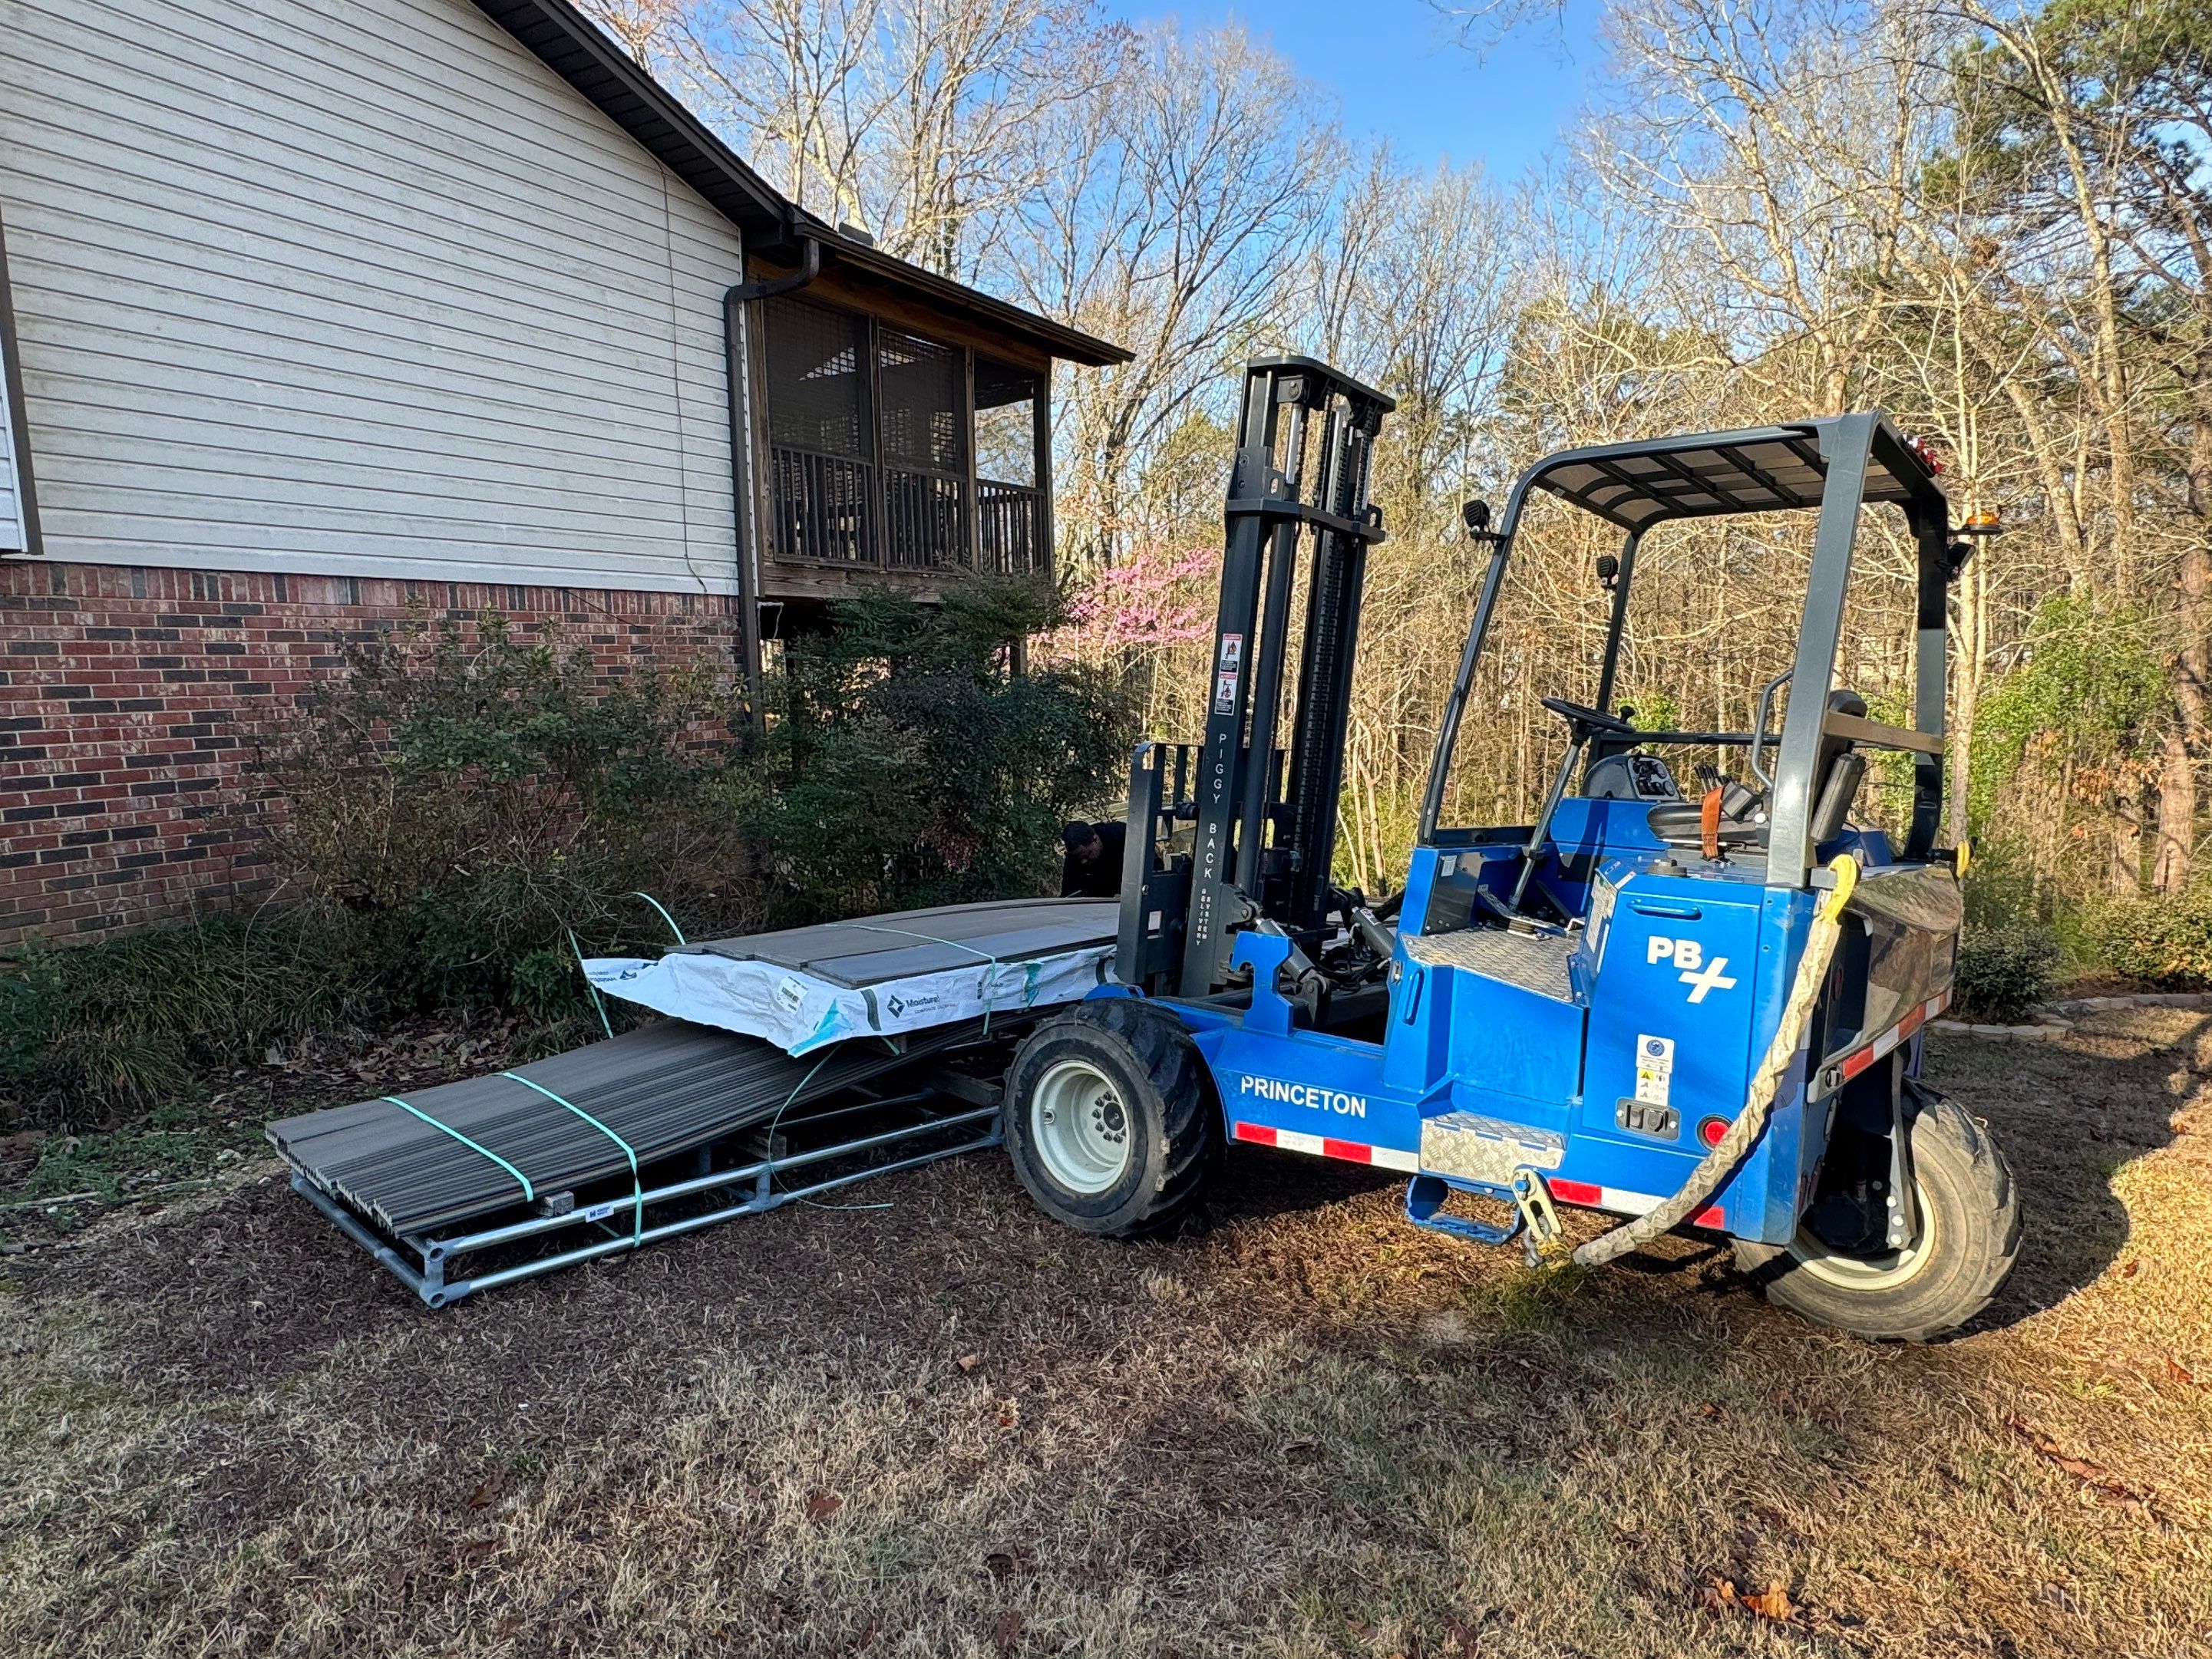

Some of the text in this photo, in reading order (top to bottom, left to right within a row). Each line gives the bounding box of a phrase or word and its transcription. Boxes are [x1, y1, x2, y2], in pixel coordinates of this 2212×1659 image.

[1203, 733, 1227, 879] PIGGY BACK
[1196, 888, 1207, 946] DELIVERY
[1202, 896, 1211, 939] SYSTEM
[1241, 1076, 1366, 1119] PRINCETON
